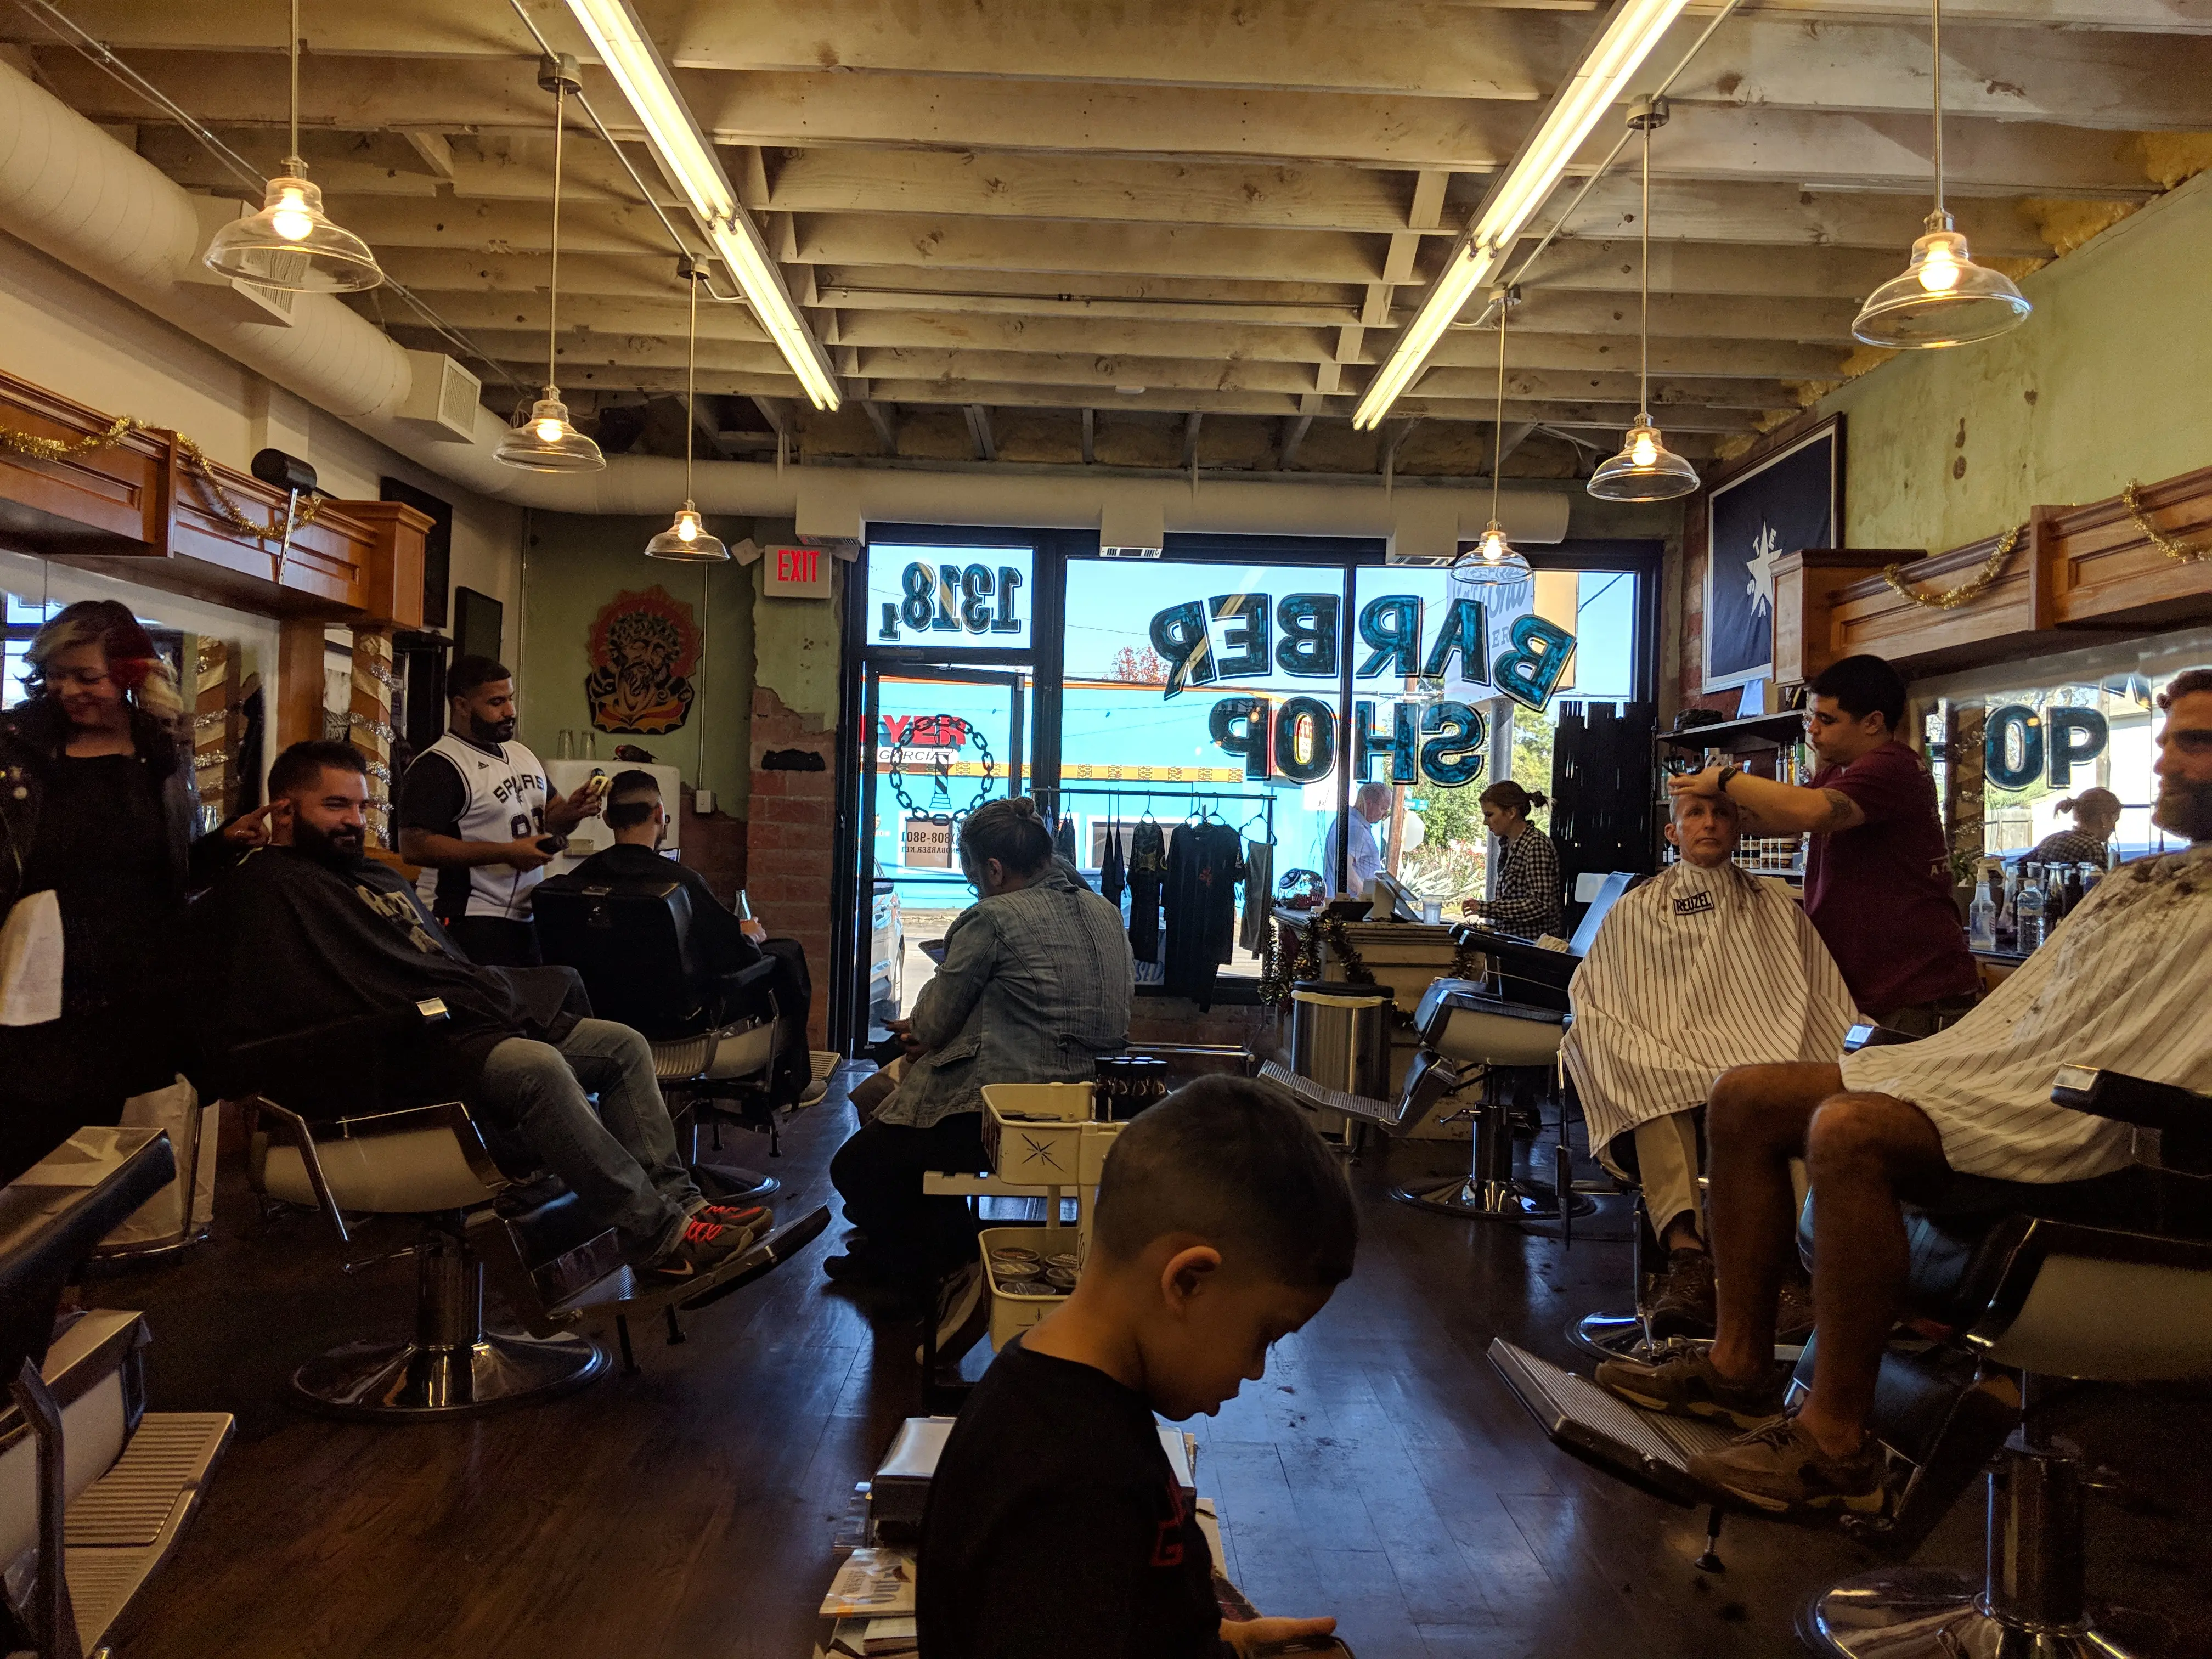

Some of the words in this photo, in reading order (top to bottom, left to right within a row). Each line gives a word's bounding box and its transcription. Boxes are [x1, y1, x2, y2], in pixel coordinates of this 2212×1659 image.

[777, 549, 820, 583] EXIT
[882, 715, 966, 745] YER
[1984, 703, 2108, 792] OP
[1677, 892, 1712, 912] REUZEL
